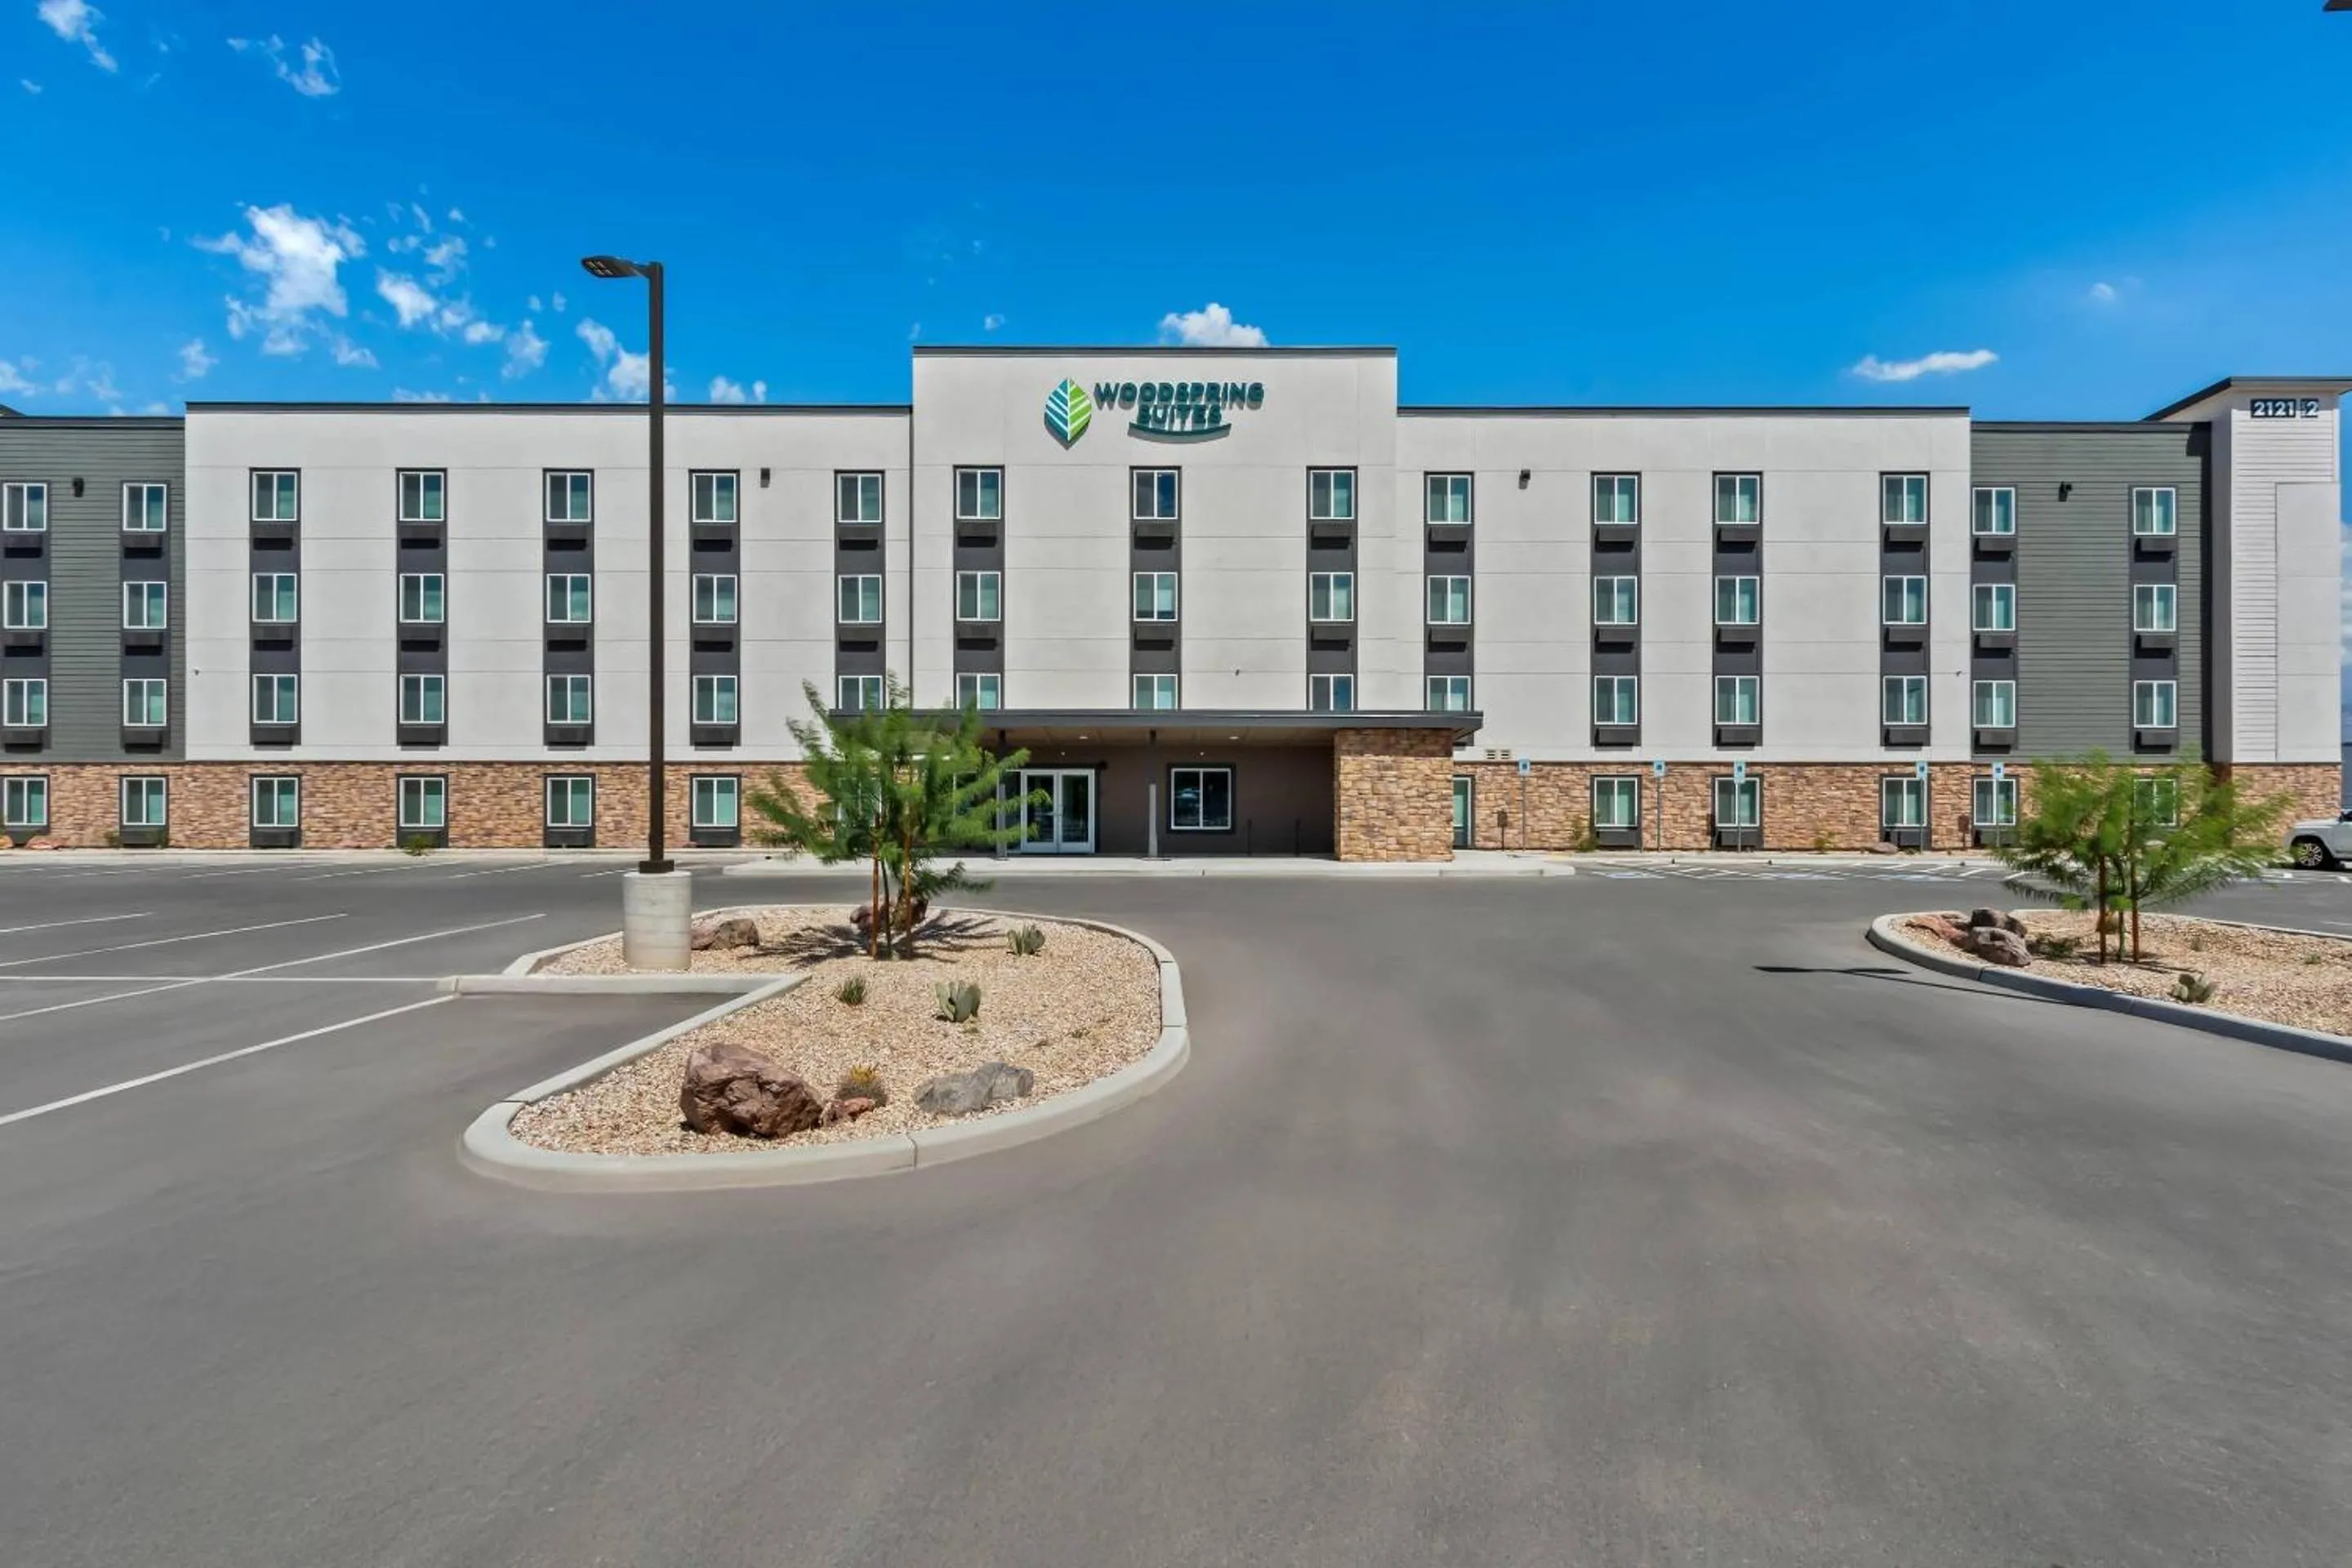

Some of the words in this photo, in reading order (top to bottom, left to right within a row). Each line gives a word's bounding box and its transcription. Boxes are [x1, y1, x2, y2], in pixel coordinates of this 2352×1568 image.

[1093, 381, 1265, 403] WOODSPRING
[1136, 403, 1223, 425] SUITES
[2253, 400, 2295, 416] 2121
[2305, 400, 2319, 416] 2
